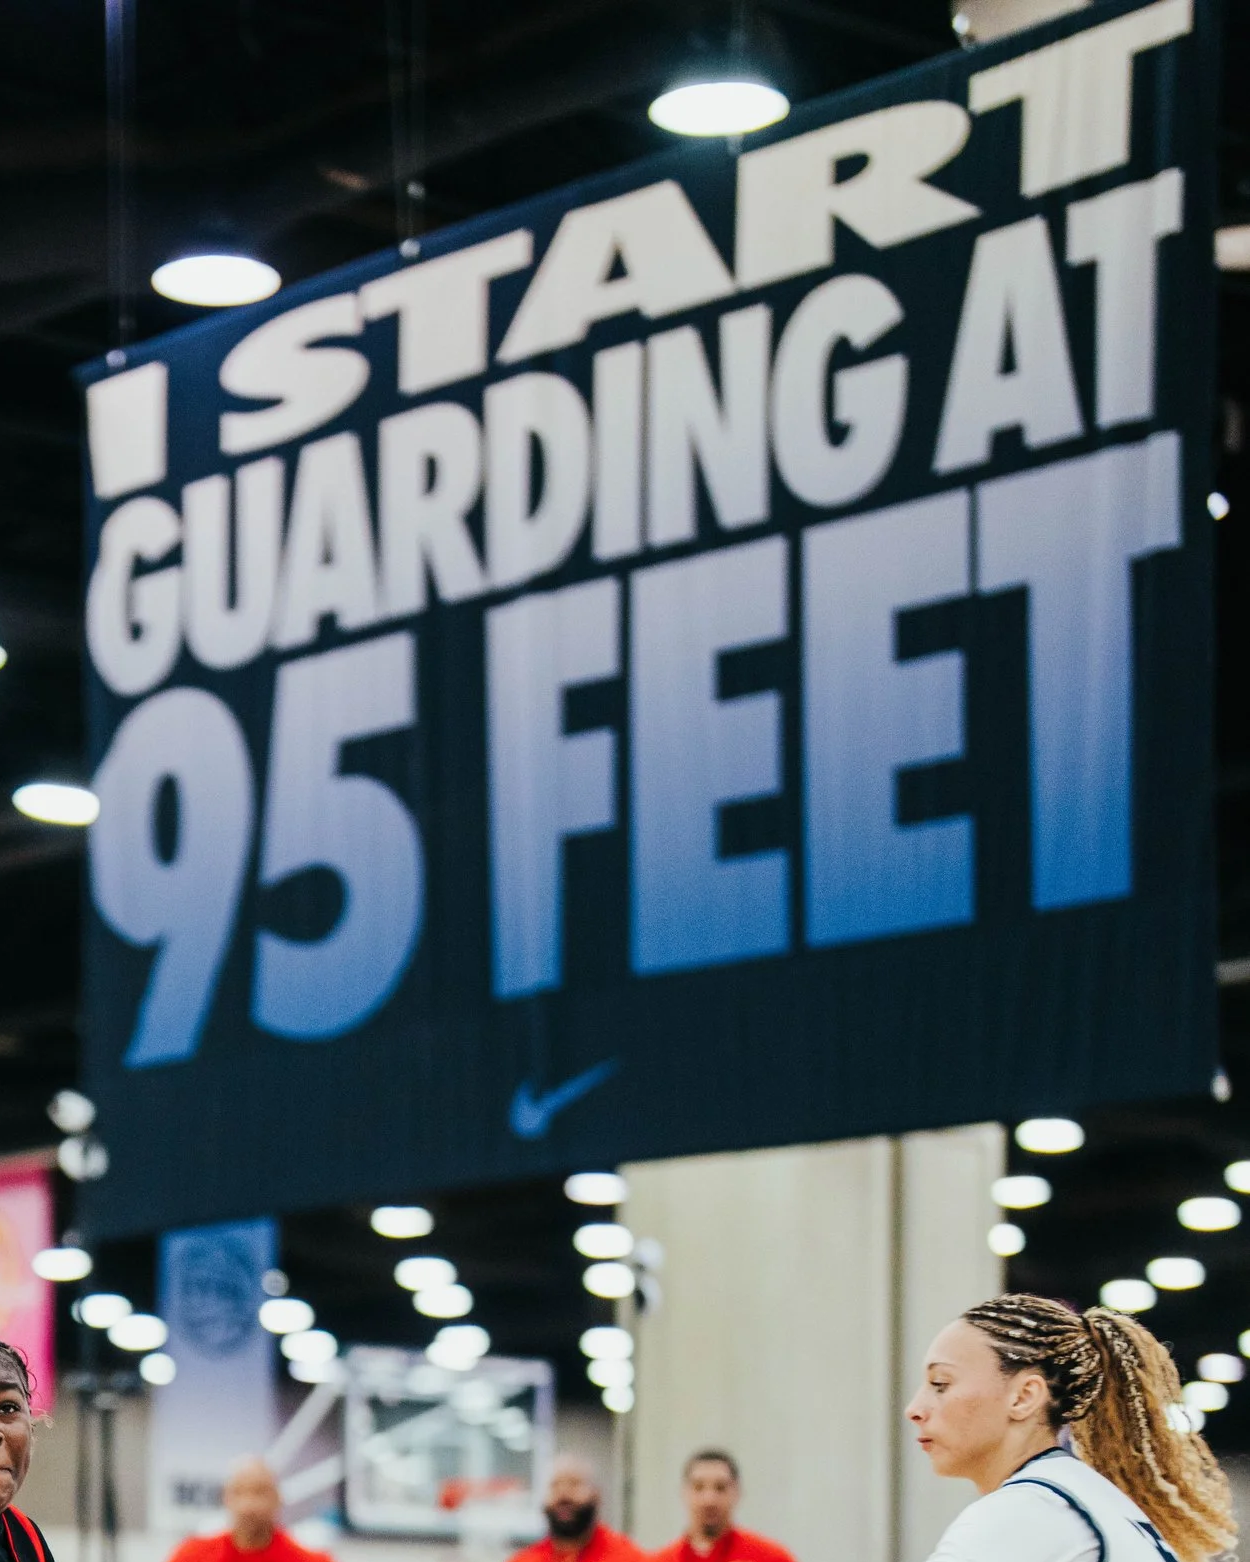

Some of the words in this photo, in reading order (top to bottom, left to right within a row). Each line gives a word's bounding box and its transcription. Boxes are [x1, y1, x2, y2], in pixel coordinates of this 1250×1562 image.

[87, 361, 168, 498] I
[218, 0, 1194, 456] START
[87, 273, 909, 696] GUARDING
[932, 168, 1184, 475] AT
[89, 632, 425, 1069] 95
[485, 432, 1183, 1000] FEET
